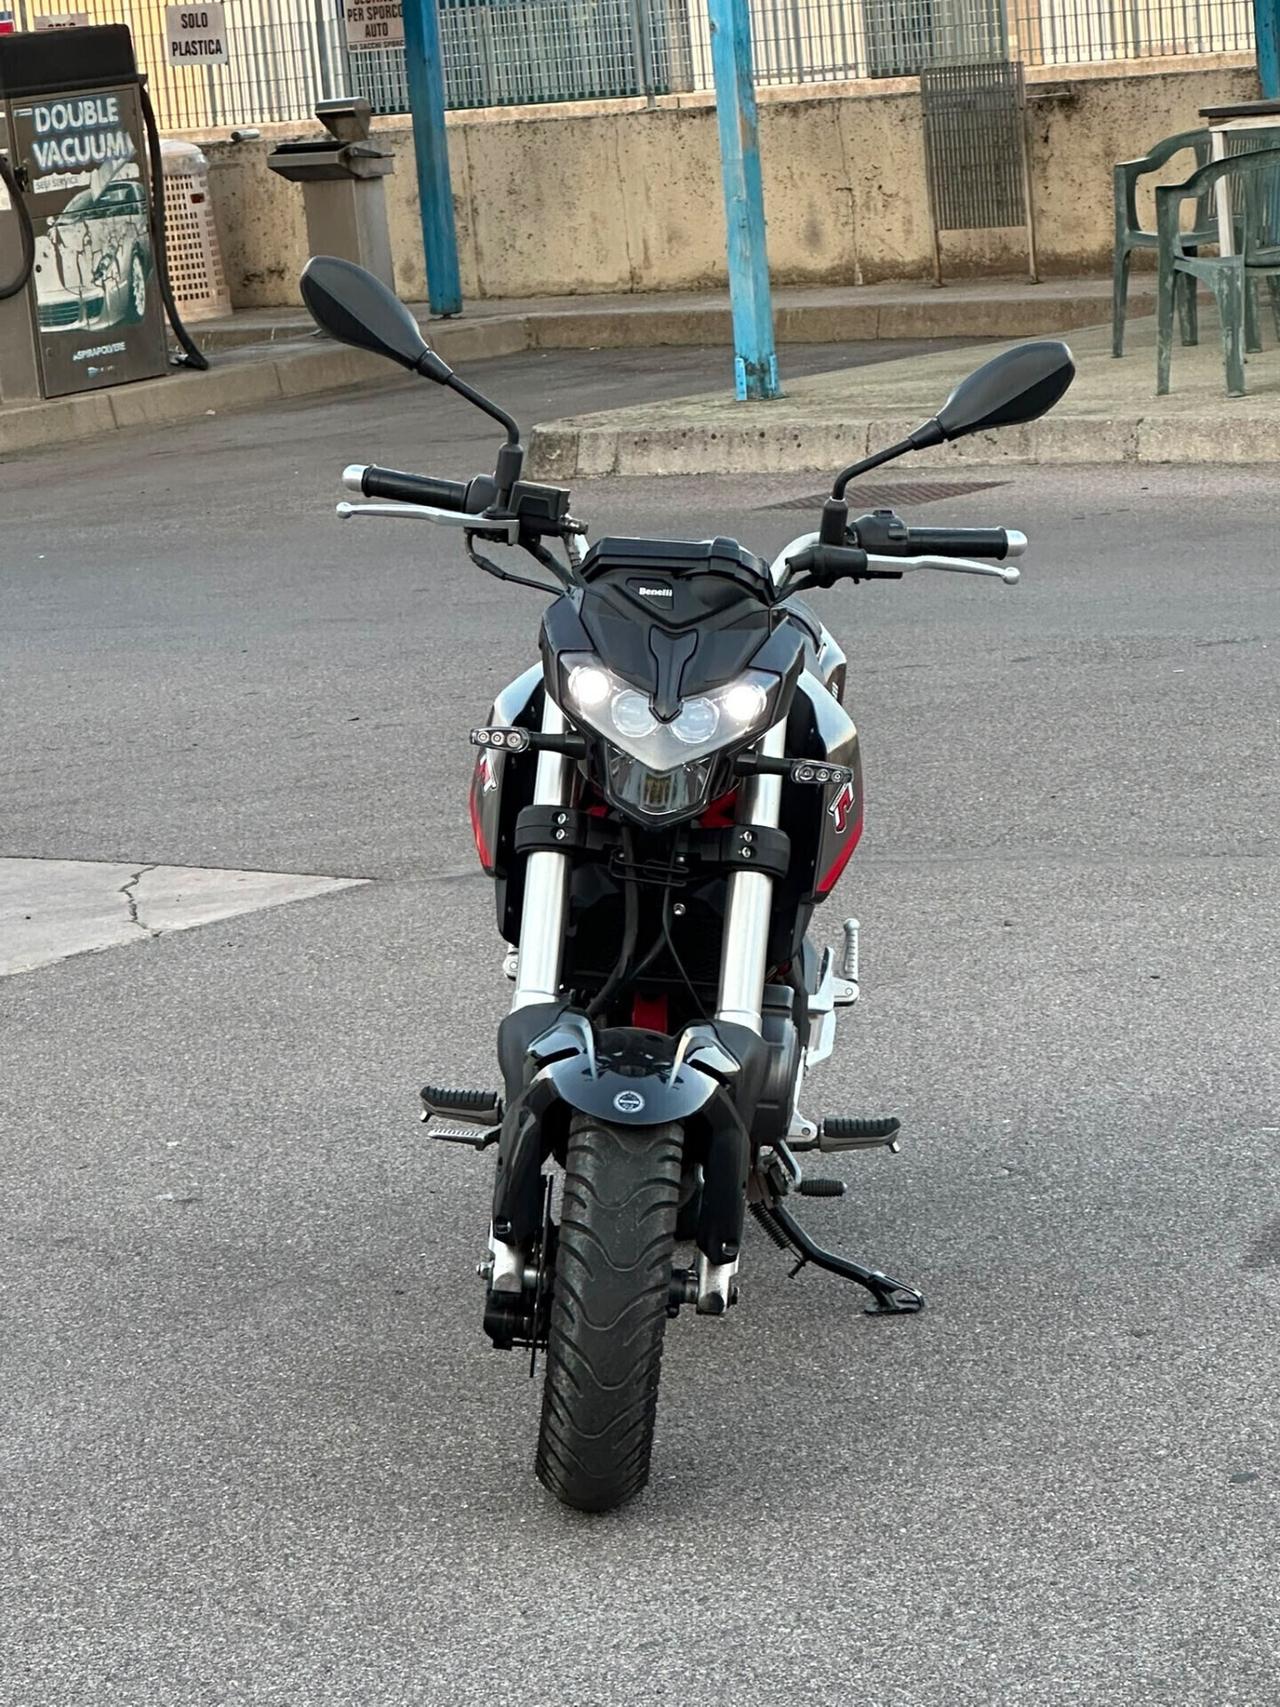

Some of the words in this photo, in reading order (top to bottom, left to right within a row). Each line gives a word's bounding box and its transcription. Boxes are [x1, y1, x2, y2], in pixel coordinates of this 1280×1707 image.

[180, 12, 209, 29] SOLO
[347, 7, 364, 22] PER
[365, 22, 389, 38] AUTO
[171, 39, 223, 57] PLASTICA
[34, 97, 119, 132] DOUBLE
[32, 131, 127, 168] VACUUM
[639, 586, 673, 598] Benelli
